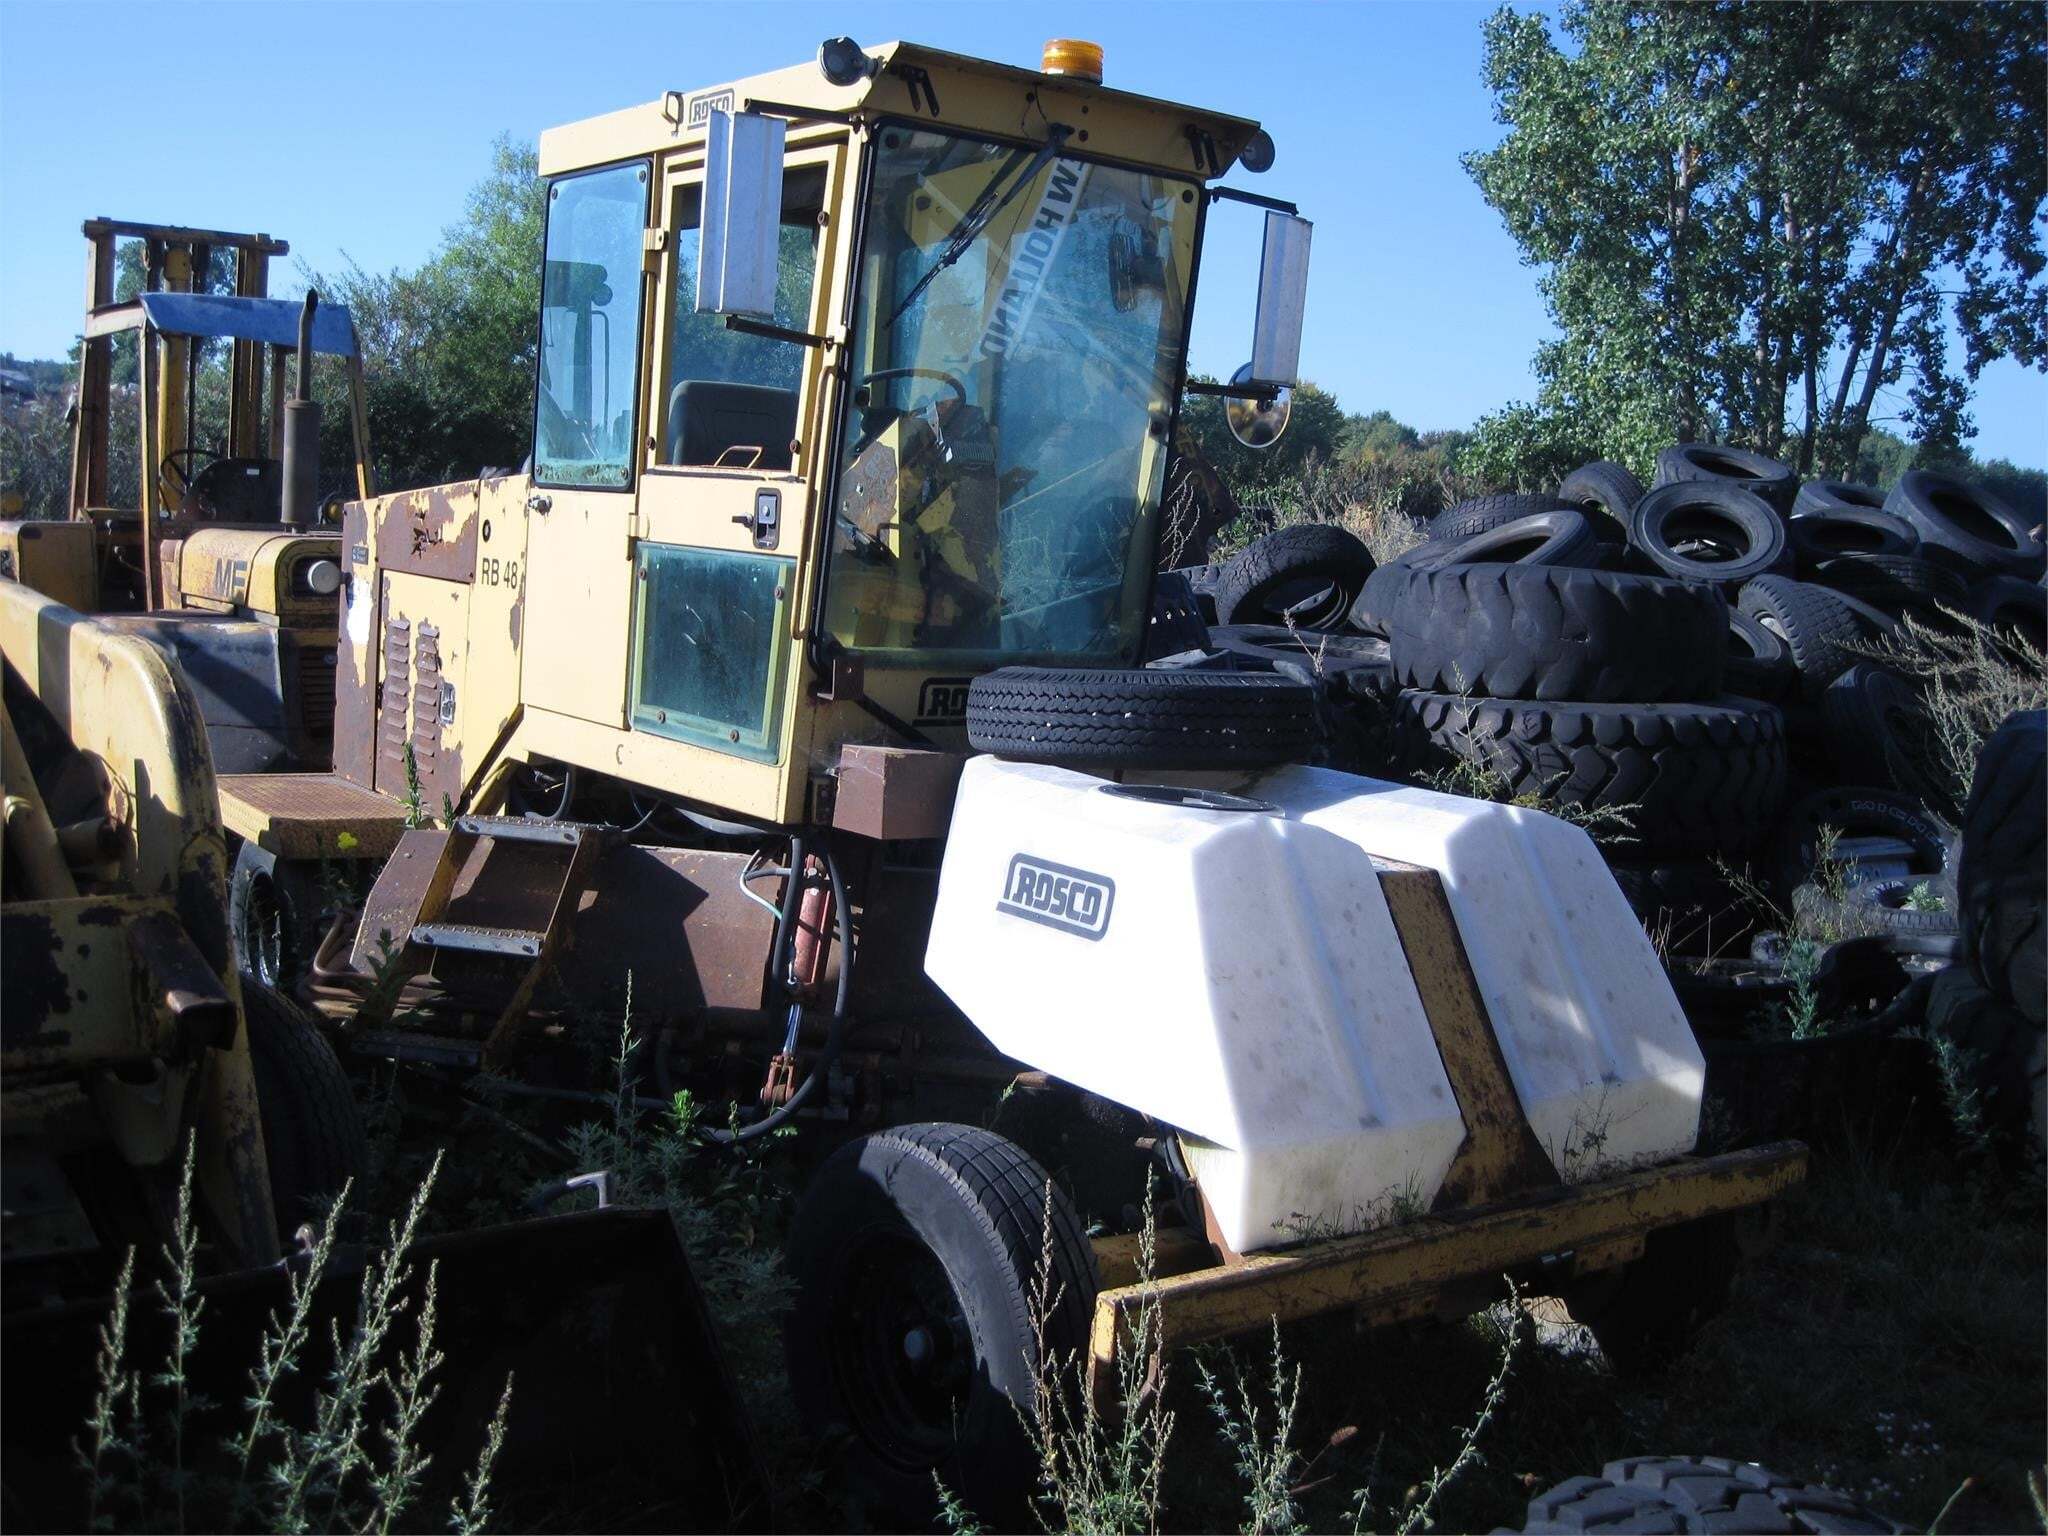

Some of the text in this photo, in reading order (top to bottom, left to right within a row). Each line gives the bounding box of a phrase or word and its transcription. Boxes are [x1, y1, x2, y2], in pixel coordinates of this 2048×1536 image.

[481, 558, 518, 589] RB 48
[1012, 866, 1103, 926] ROSCO
